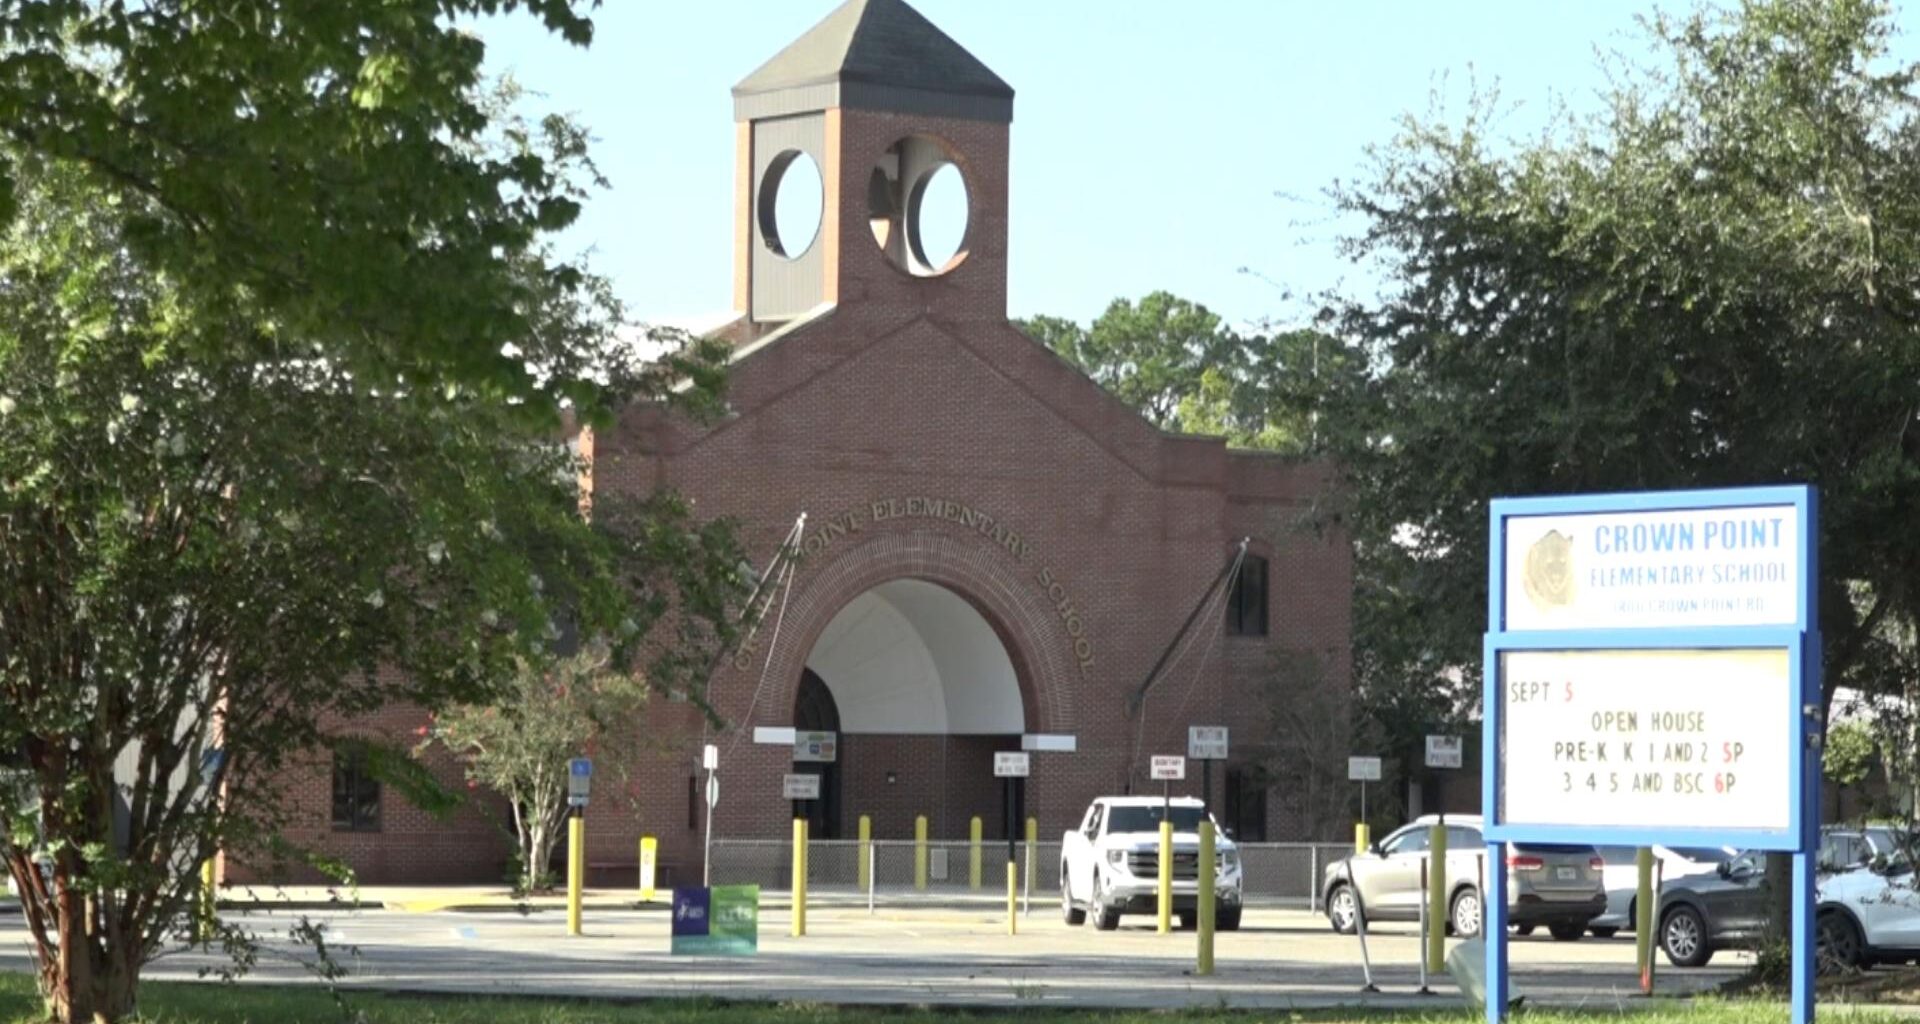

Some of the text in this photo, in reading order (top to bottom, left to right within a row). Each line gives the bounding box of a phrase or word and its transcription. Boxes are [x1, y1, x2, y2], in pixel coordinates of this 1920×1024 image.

[1595, 518, 1783, 554] CROWN POINT
[1591, 561, 1787, 588] ELEMENTARY SCHOOL
[872, 498, 1031, 559] ELEMENTARY
[1036, 566, 1097, 674] SCHOOL
[1648, 599, 1698, 613] CROWN
[1703, 597, 1740, 611] POINT
[1510, 681, 1573, 702] SEPT 5
[1591, 711, 1705, 732] OPEN HOUSE
[1554, 741, 1607, 762] PRE-K
[1624, 741, 1633, 762] K
[1663, 741, 1693, 762] AND
[1700, 741, 1708, 762] 2
[1722, 741, 1744, 763] 5P
[1563, 772, 1736, 794] 3 4 5 AND BSC 6P
